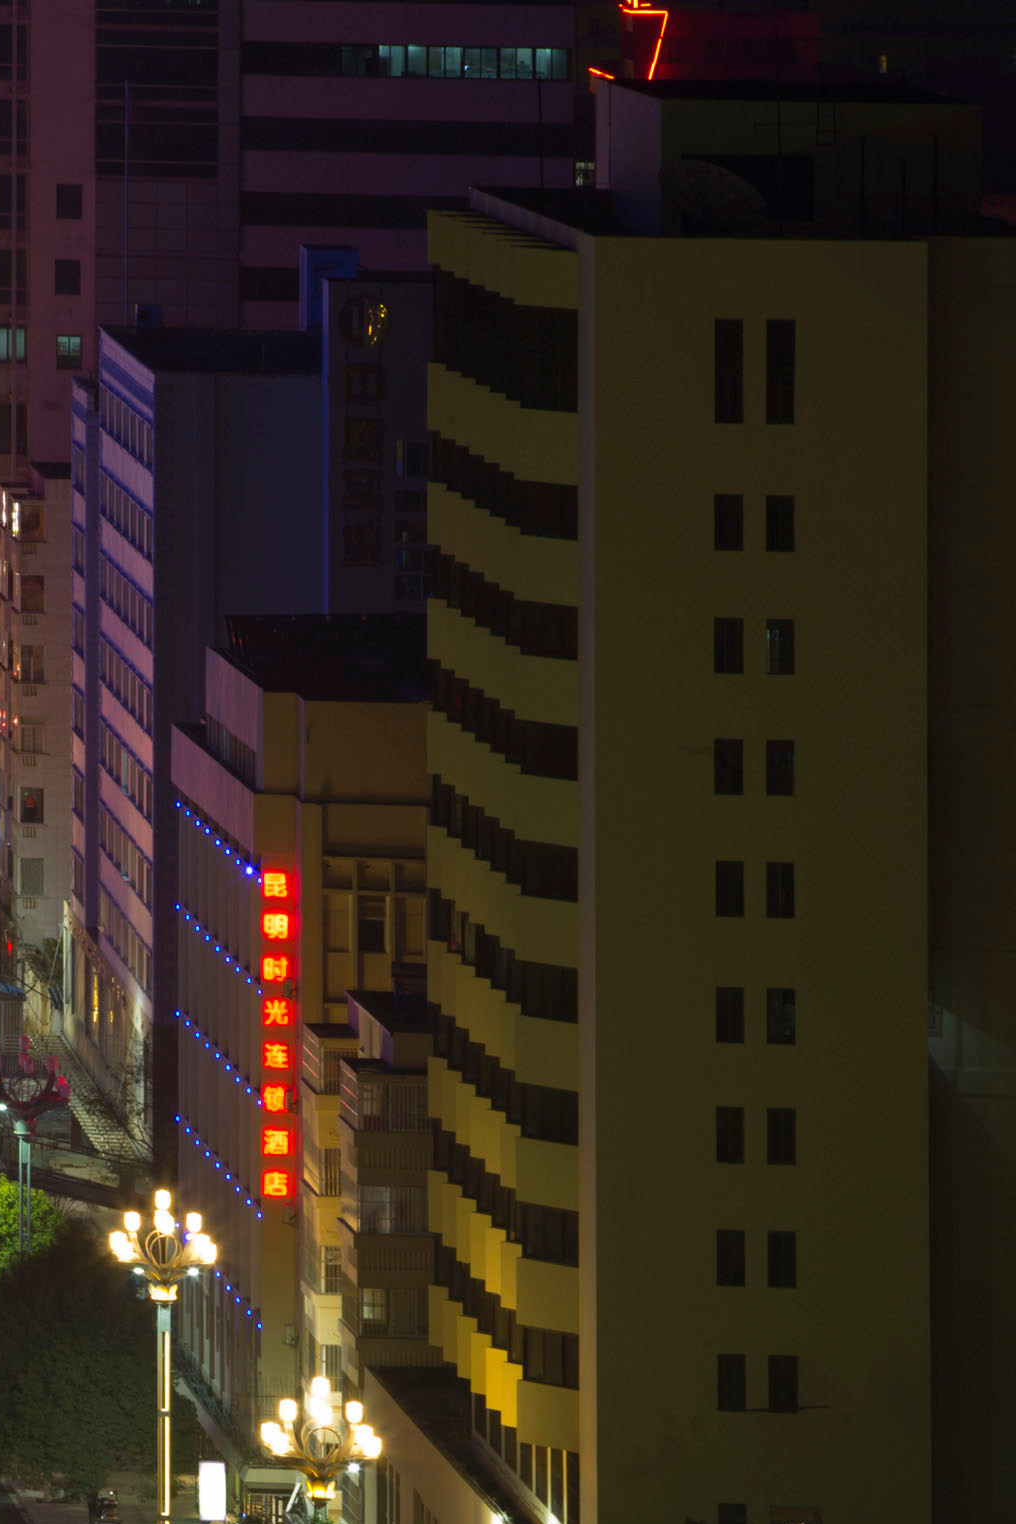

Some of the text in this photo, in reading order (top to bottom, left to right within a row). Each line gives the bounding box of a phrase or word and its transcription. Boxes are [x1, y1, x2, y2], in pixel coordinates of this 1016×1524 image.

[262, 872, 289, 1197] 昆明时光连锁酒店
